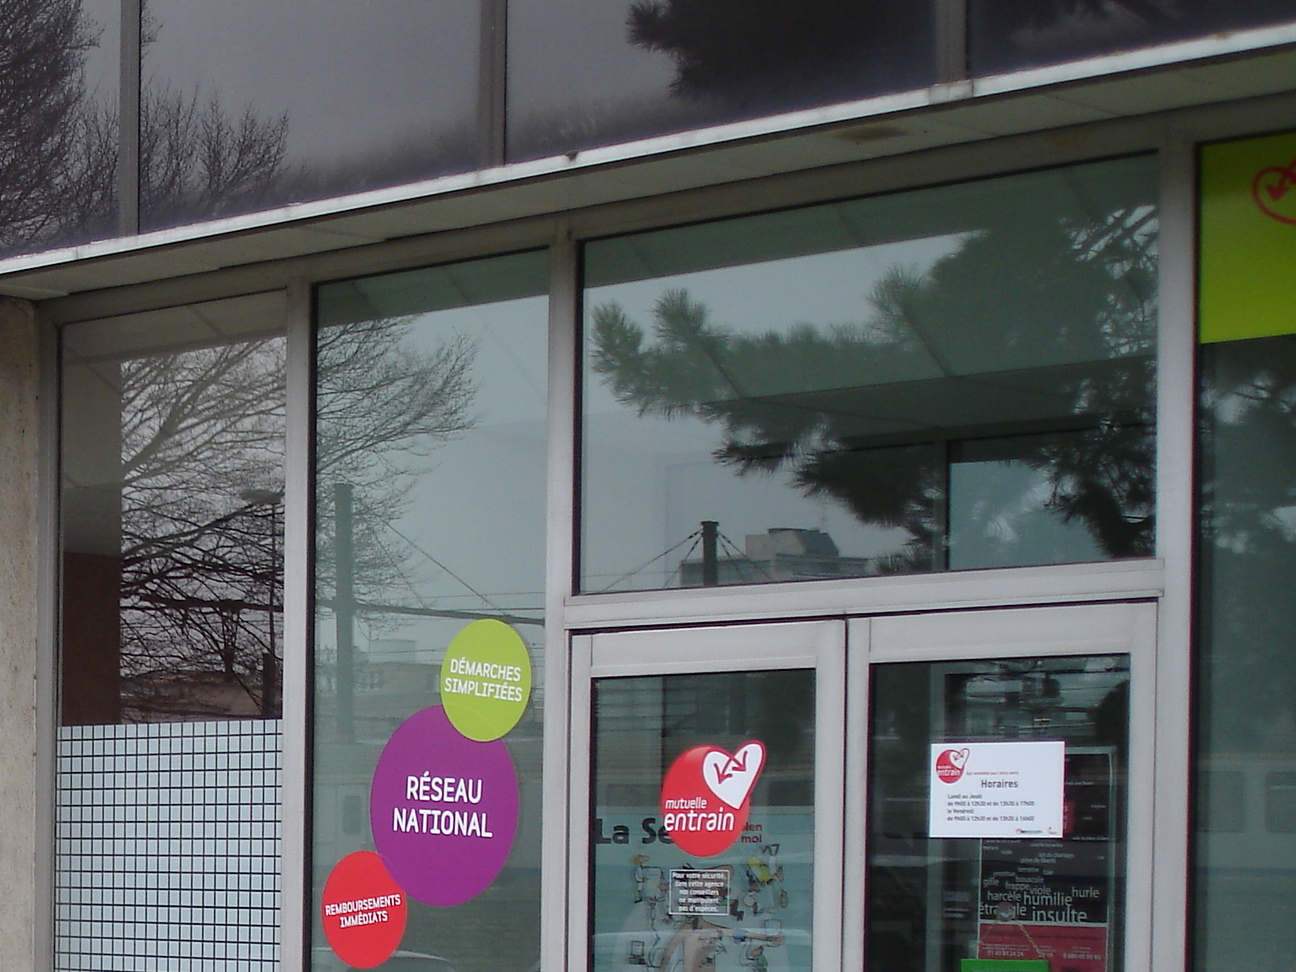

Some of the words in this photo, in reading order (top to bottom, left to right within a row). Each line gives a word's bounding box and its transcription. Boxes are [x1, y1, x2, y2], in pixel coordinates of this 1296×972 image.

[450, 656, 521, 682] DÉMARCHES
[444, 677, 523, 702] SIMPLIFIÉES
[406, 770, 482, 803] RÉSEAU
[981, 779, 1019, 788] Horaires
[665, 796, 708, 809] mutuelle
[393, 807, 493, 837] NATIONAL
[664, 807, 735, 831] entrain
[593, 818, 630, 845] La
[987, 890, 1022, 902] harcèle
[1024, 892, 1073, 906] humilie
[1029, 885, 1051, 895] viole
[1071, 886, 1100, 898] hurle
[325, 894, 401, 916] REMBOURSEMENTS
[339, 910, 388, 928] IMMÉDIATS
[1032, 906, 1087, 923] insulte
